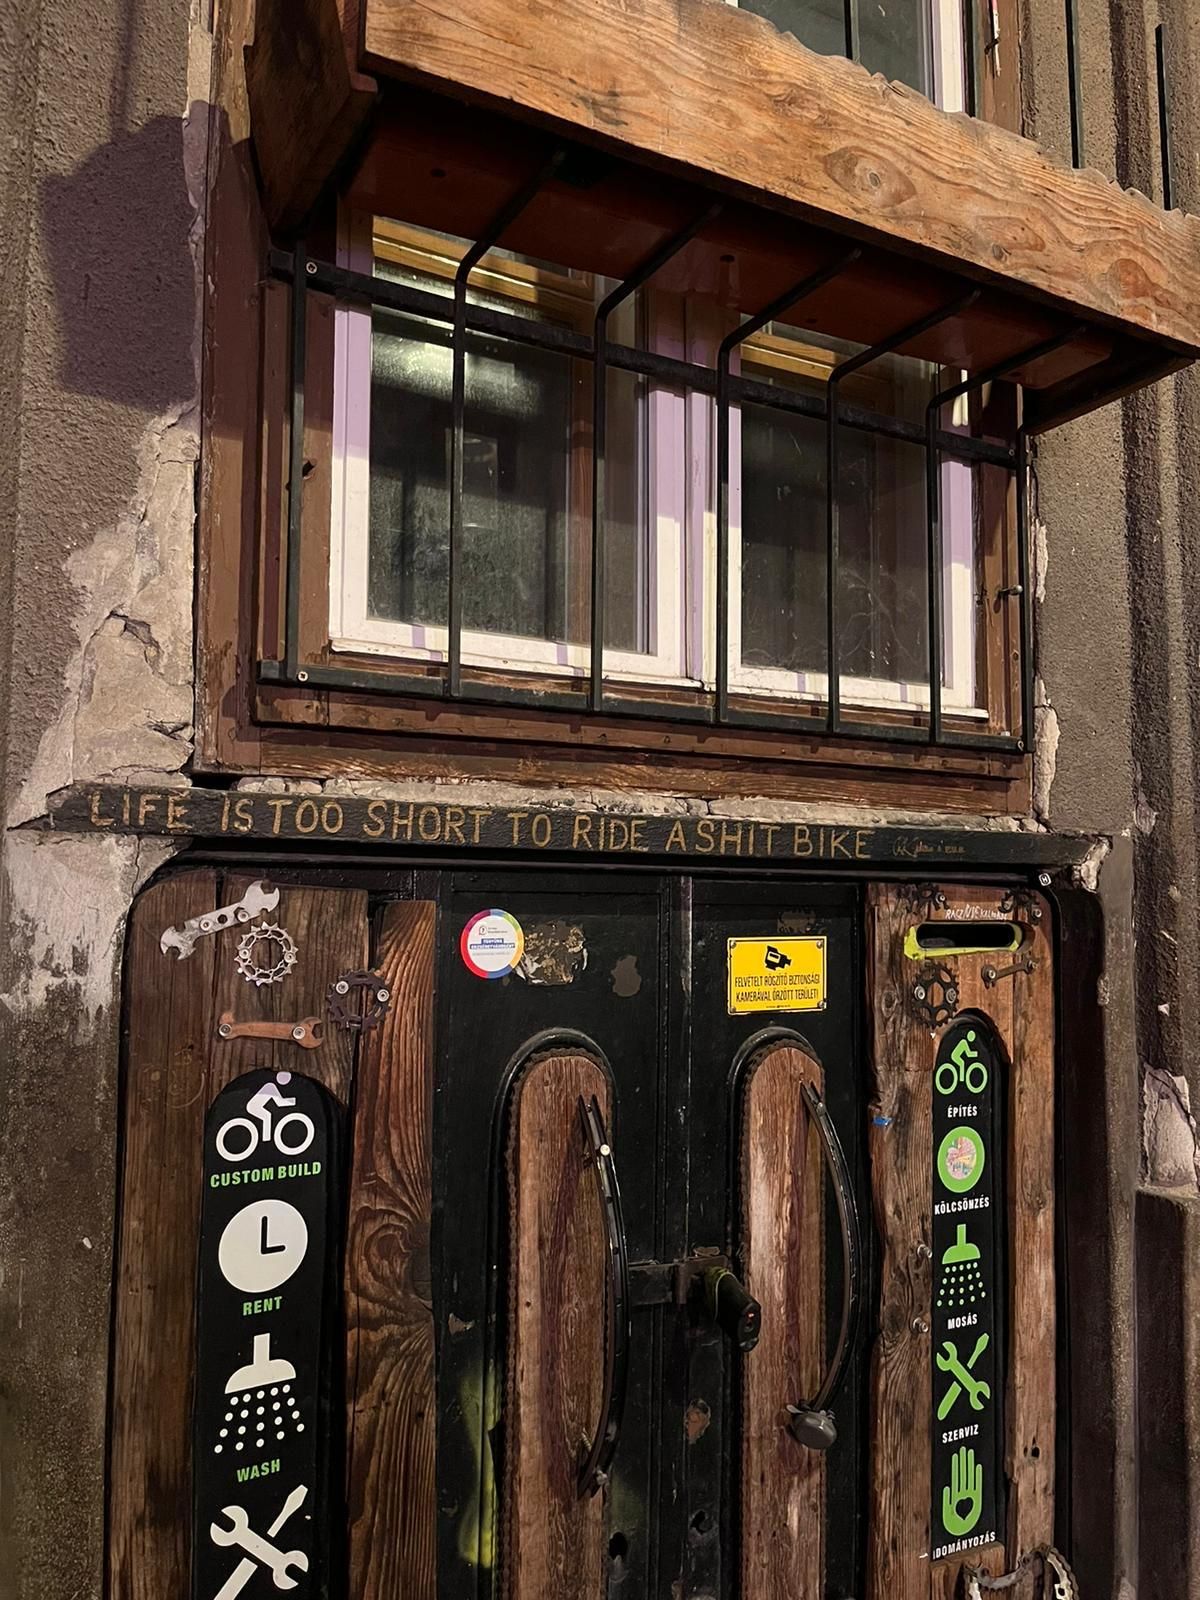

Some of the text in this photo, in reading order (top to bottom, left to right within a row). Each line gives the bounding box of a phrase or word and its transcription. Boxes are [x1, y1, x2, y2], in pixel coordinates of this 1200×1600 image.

[90, 789, 193, 829] LIFE
[221, 797, 254, 831] IS
[267, 799, 344, 834] TOO
[363, 801, 492, 844] SHORT
[508, 812, 551, 847] TO
[572, 815, 649, 852] RIDE
[794, 825, 876, 858] BIKE
[947, 1104, 978, 1118] ÉPÍTÉS
[210, 1162, 322, 1188] CUSTOM BUILD
[934, 1194, 990, 1215] KÖLCSÖNZÉS
[243, 1296, 283, 1316] RENT
[947, 1312, 978, 1330] MOSÁS
[942, 1424, 979, 1444] SZERVIZ
[236, 1458, 281, 1483] WASH
